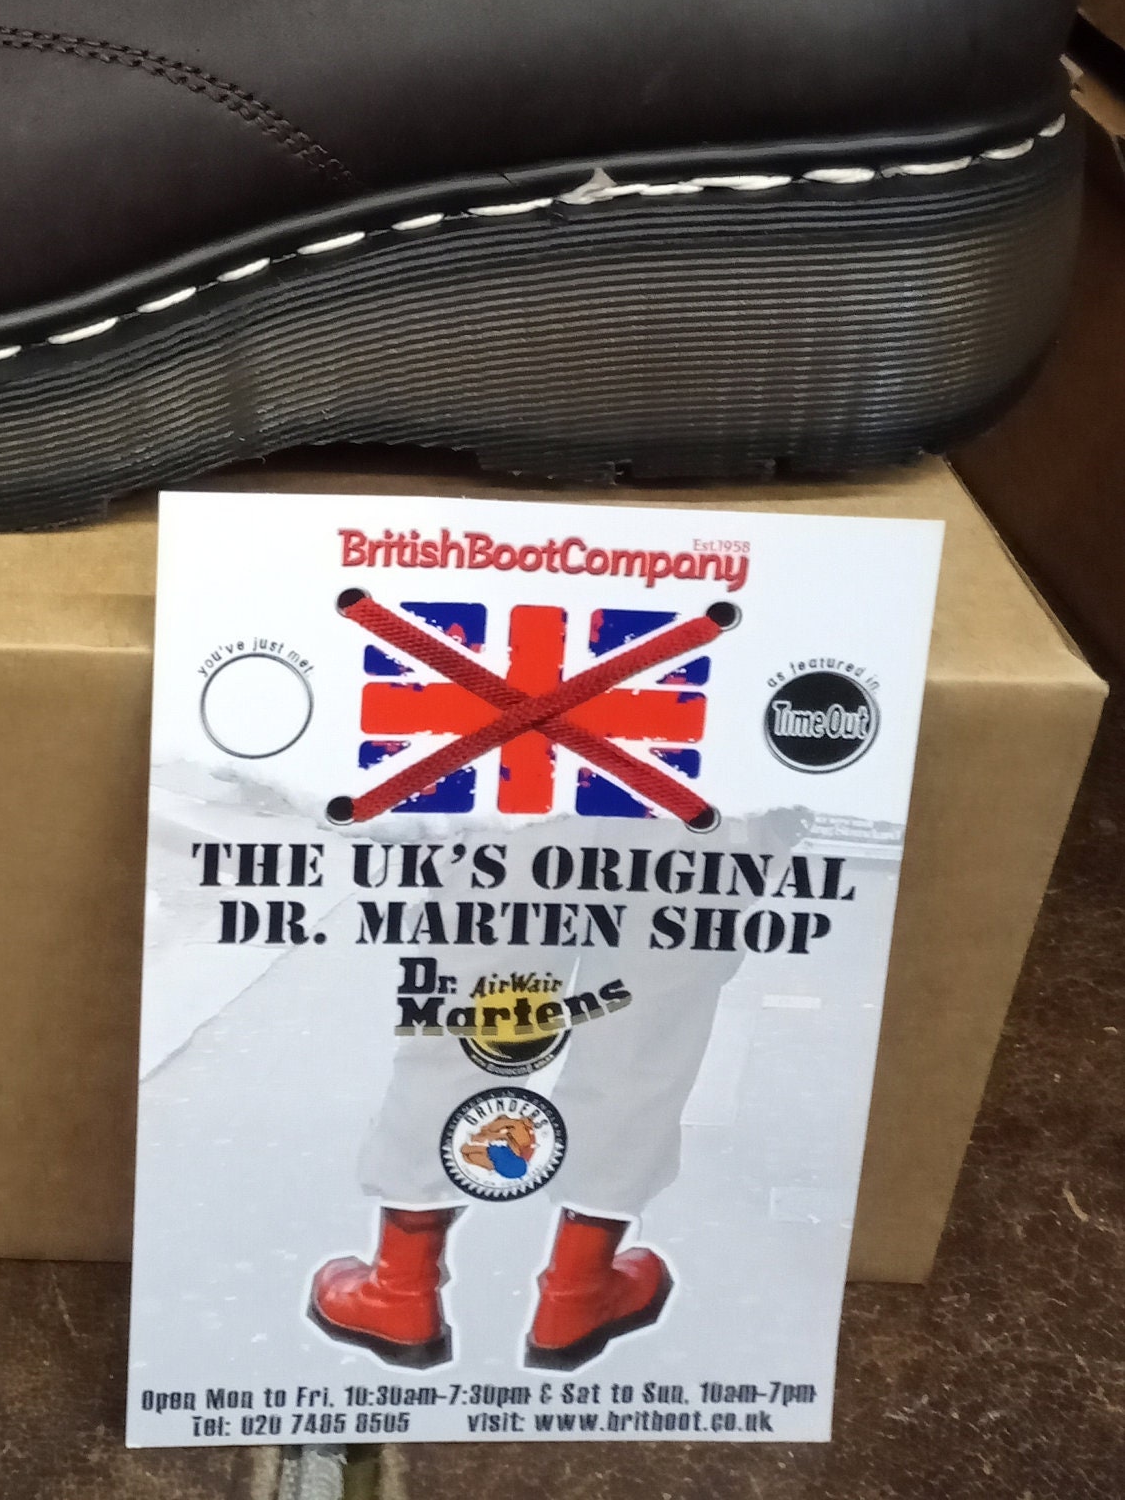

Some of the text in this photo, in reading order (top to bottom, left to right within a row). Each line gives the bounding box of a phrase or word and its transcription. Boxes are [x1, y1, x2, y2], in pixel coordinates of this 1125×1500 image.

[338, 528, 751, 593] BritishBootCompany
[252, 637, 285, 656] just
[192, 843, 324, 887] THE
[531, 845, 856, 900] ORIGINAL
[217, 900, 832, 954] DR. MARTEN SHOP
[397, 957, 564, 998] Dr. AirWair
[394, 979, 633, 1037] Martens
[141, 1389, 196, 1414] Open
[206, 1388, 253, 1410] Mon
[264, 1387, 286, 1408] to
[561, 1382, 601, 1405] Sat
[611, 1383, 634, 1404] to
